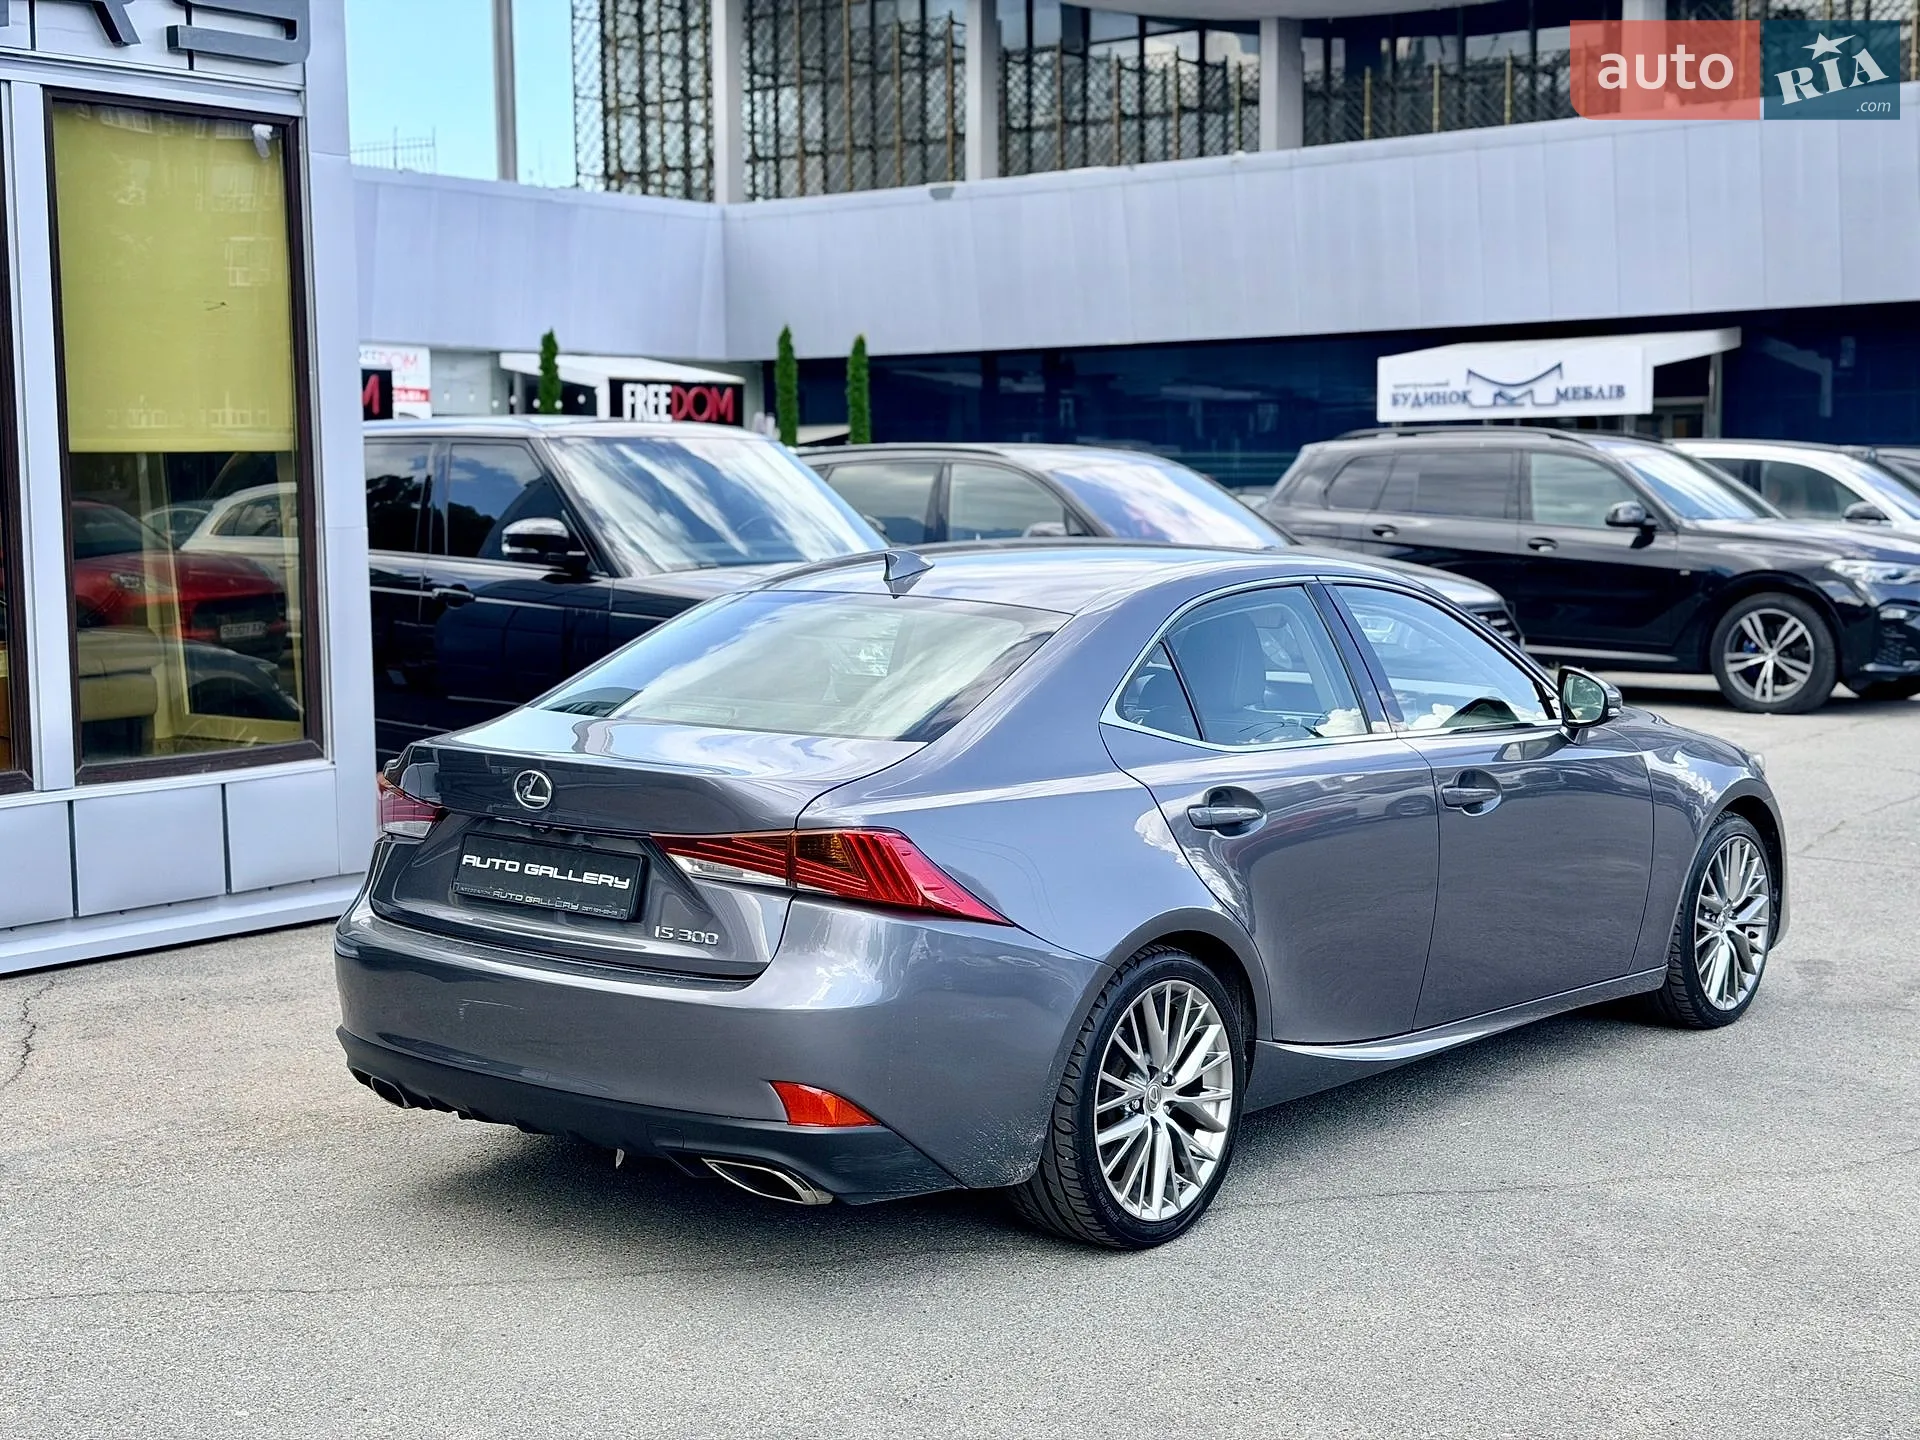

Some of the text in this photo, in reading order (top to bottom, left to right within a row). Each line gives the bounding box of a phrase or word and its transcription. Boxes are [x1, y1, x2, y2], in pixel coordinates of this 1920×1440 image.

[622, 382, 734, 423] FREEDOM
[1391, 385, 1625, 408] БУДИНОК МЕБЛІВ
[462, 854, 630, 890] AUTO GALLERY
[492, 890, 523, 902] AUTO
[525, 895, 580, 911] GALLERY
[654, 925, 719, 945] IS 300
